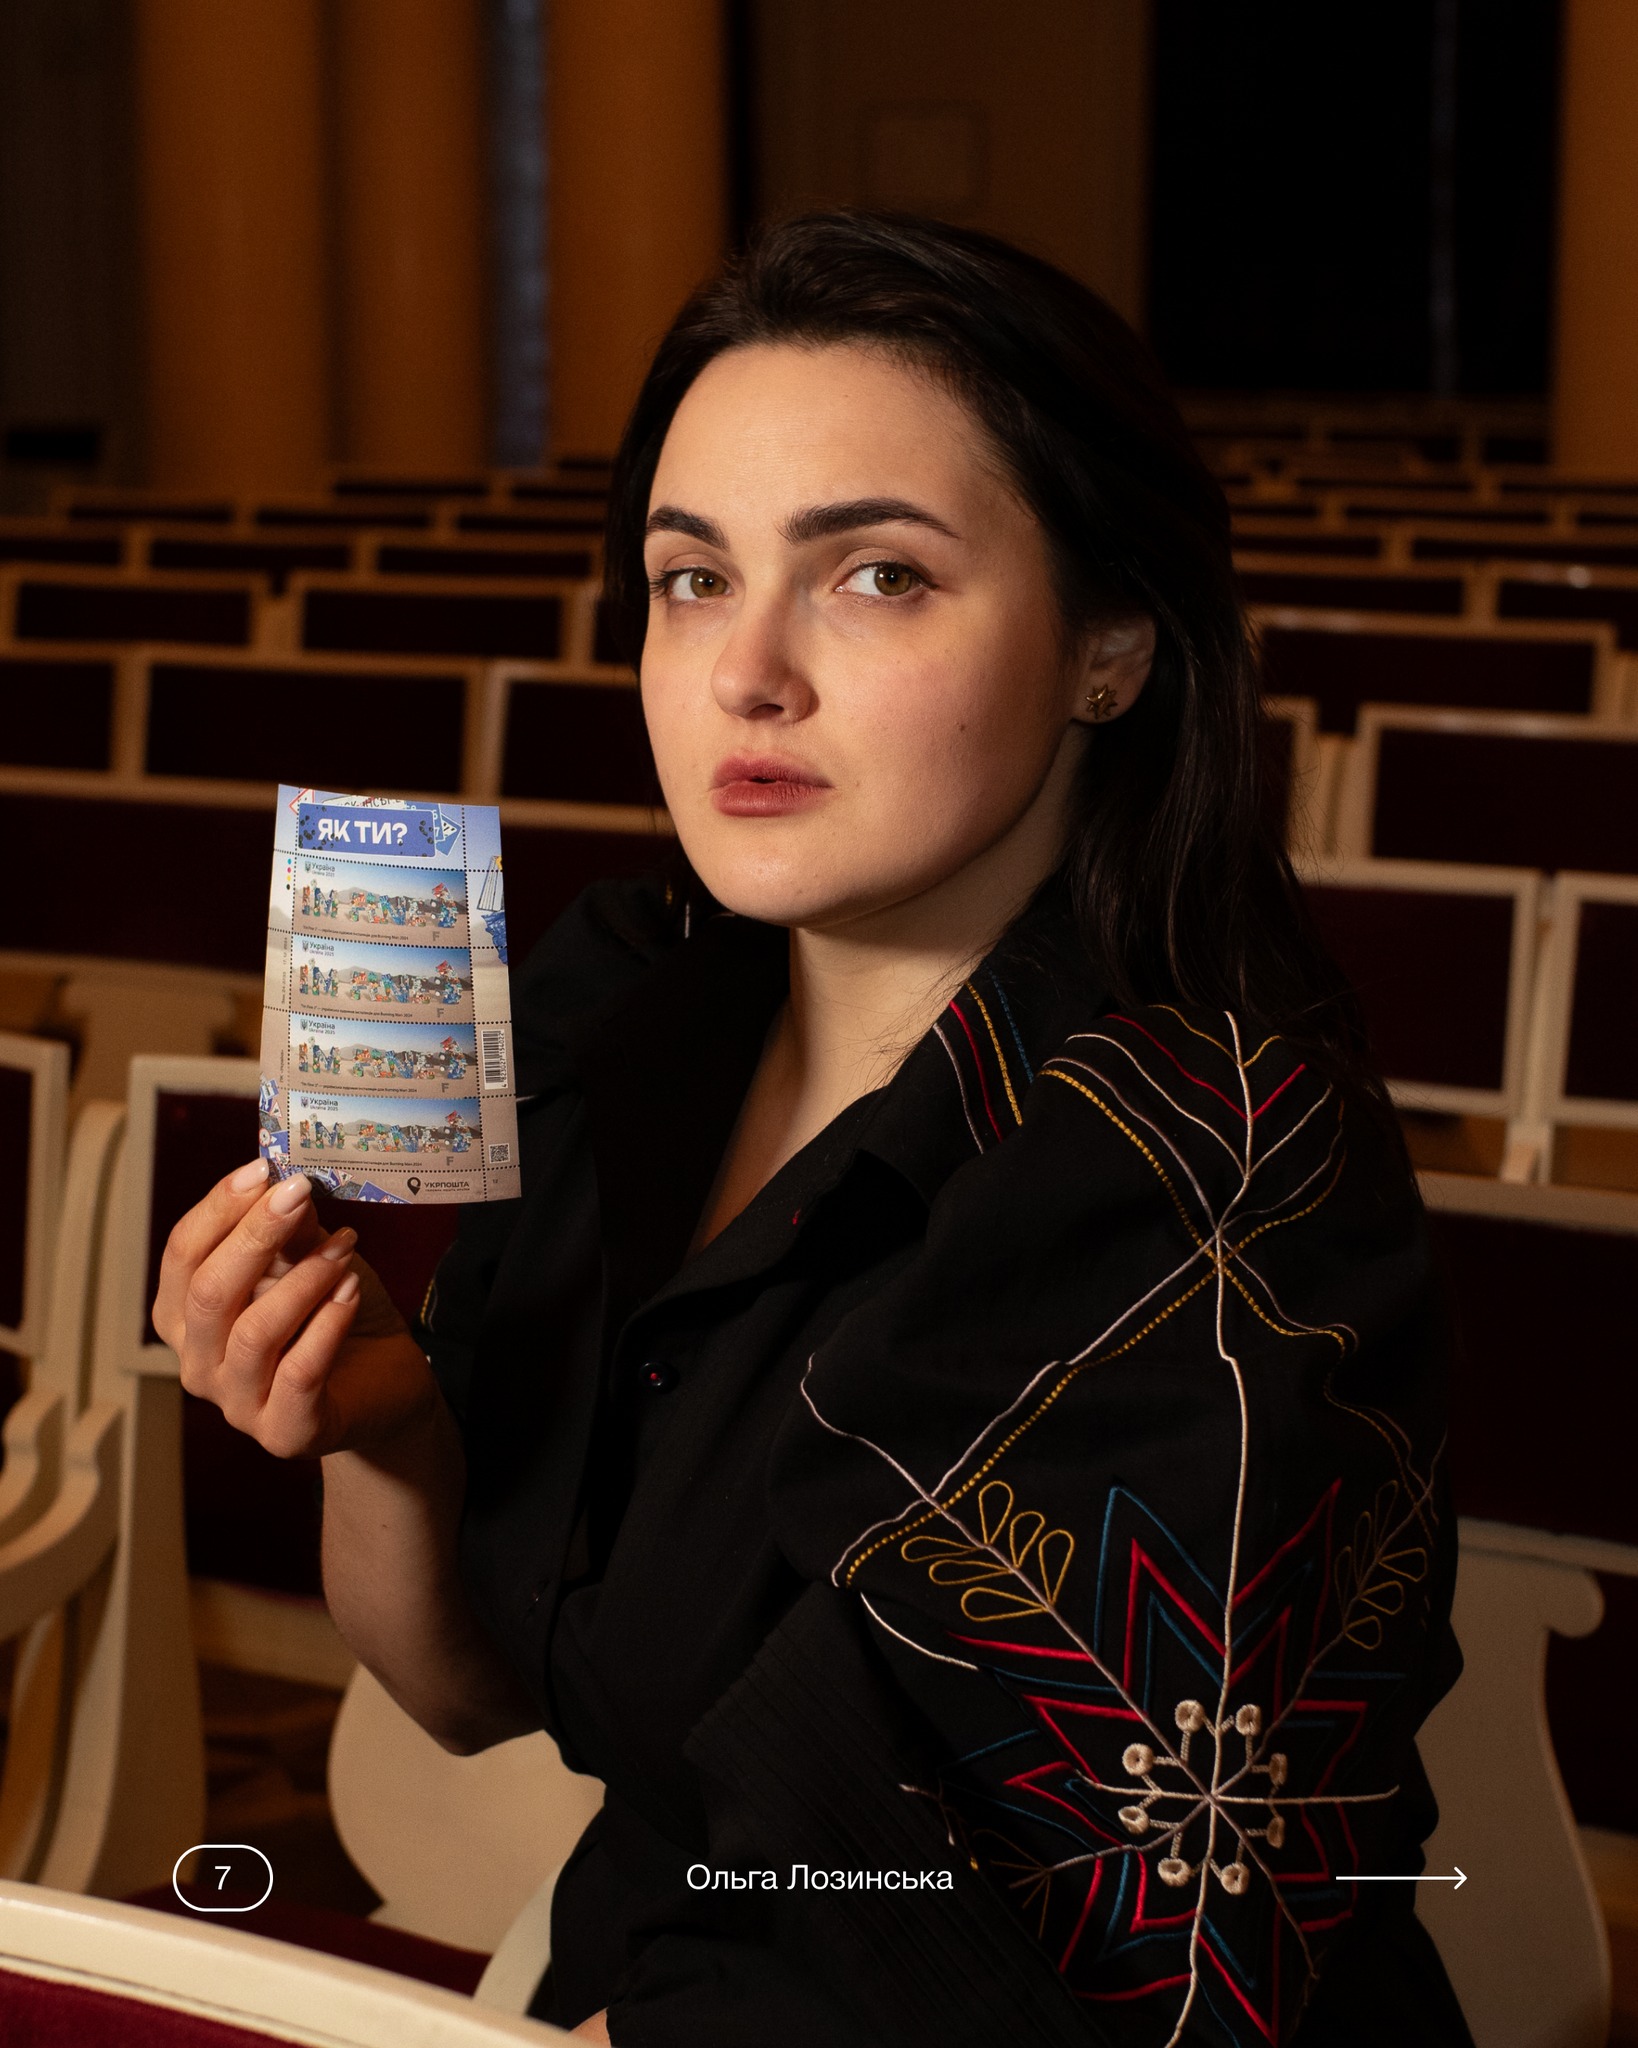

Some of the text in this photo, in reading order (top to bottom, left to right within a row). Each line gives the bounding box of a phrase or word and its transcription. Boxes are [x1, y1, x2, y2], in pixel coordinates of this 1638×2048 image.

[318, 818, 408, 845] ЯК ТИ?
[432, 931, 440, 941] F
[310, 941, 335, 951] Україна
[437, 1008, 445, 1018] F
[309, 1020, 335, 1029] Україна
[442, 1083, 449, 1093] F
[310, 1097, 338, 1106] Україна
[446, 1156, 454, 1166] F
